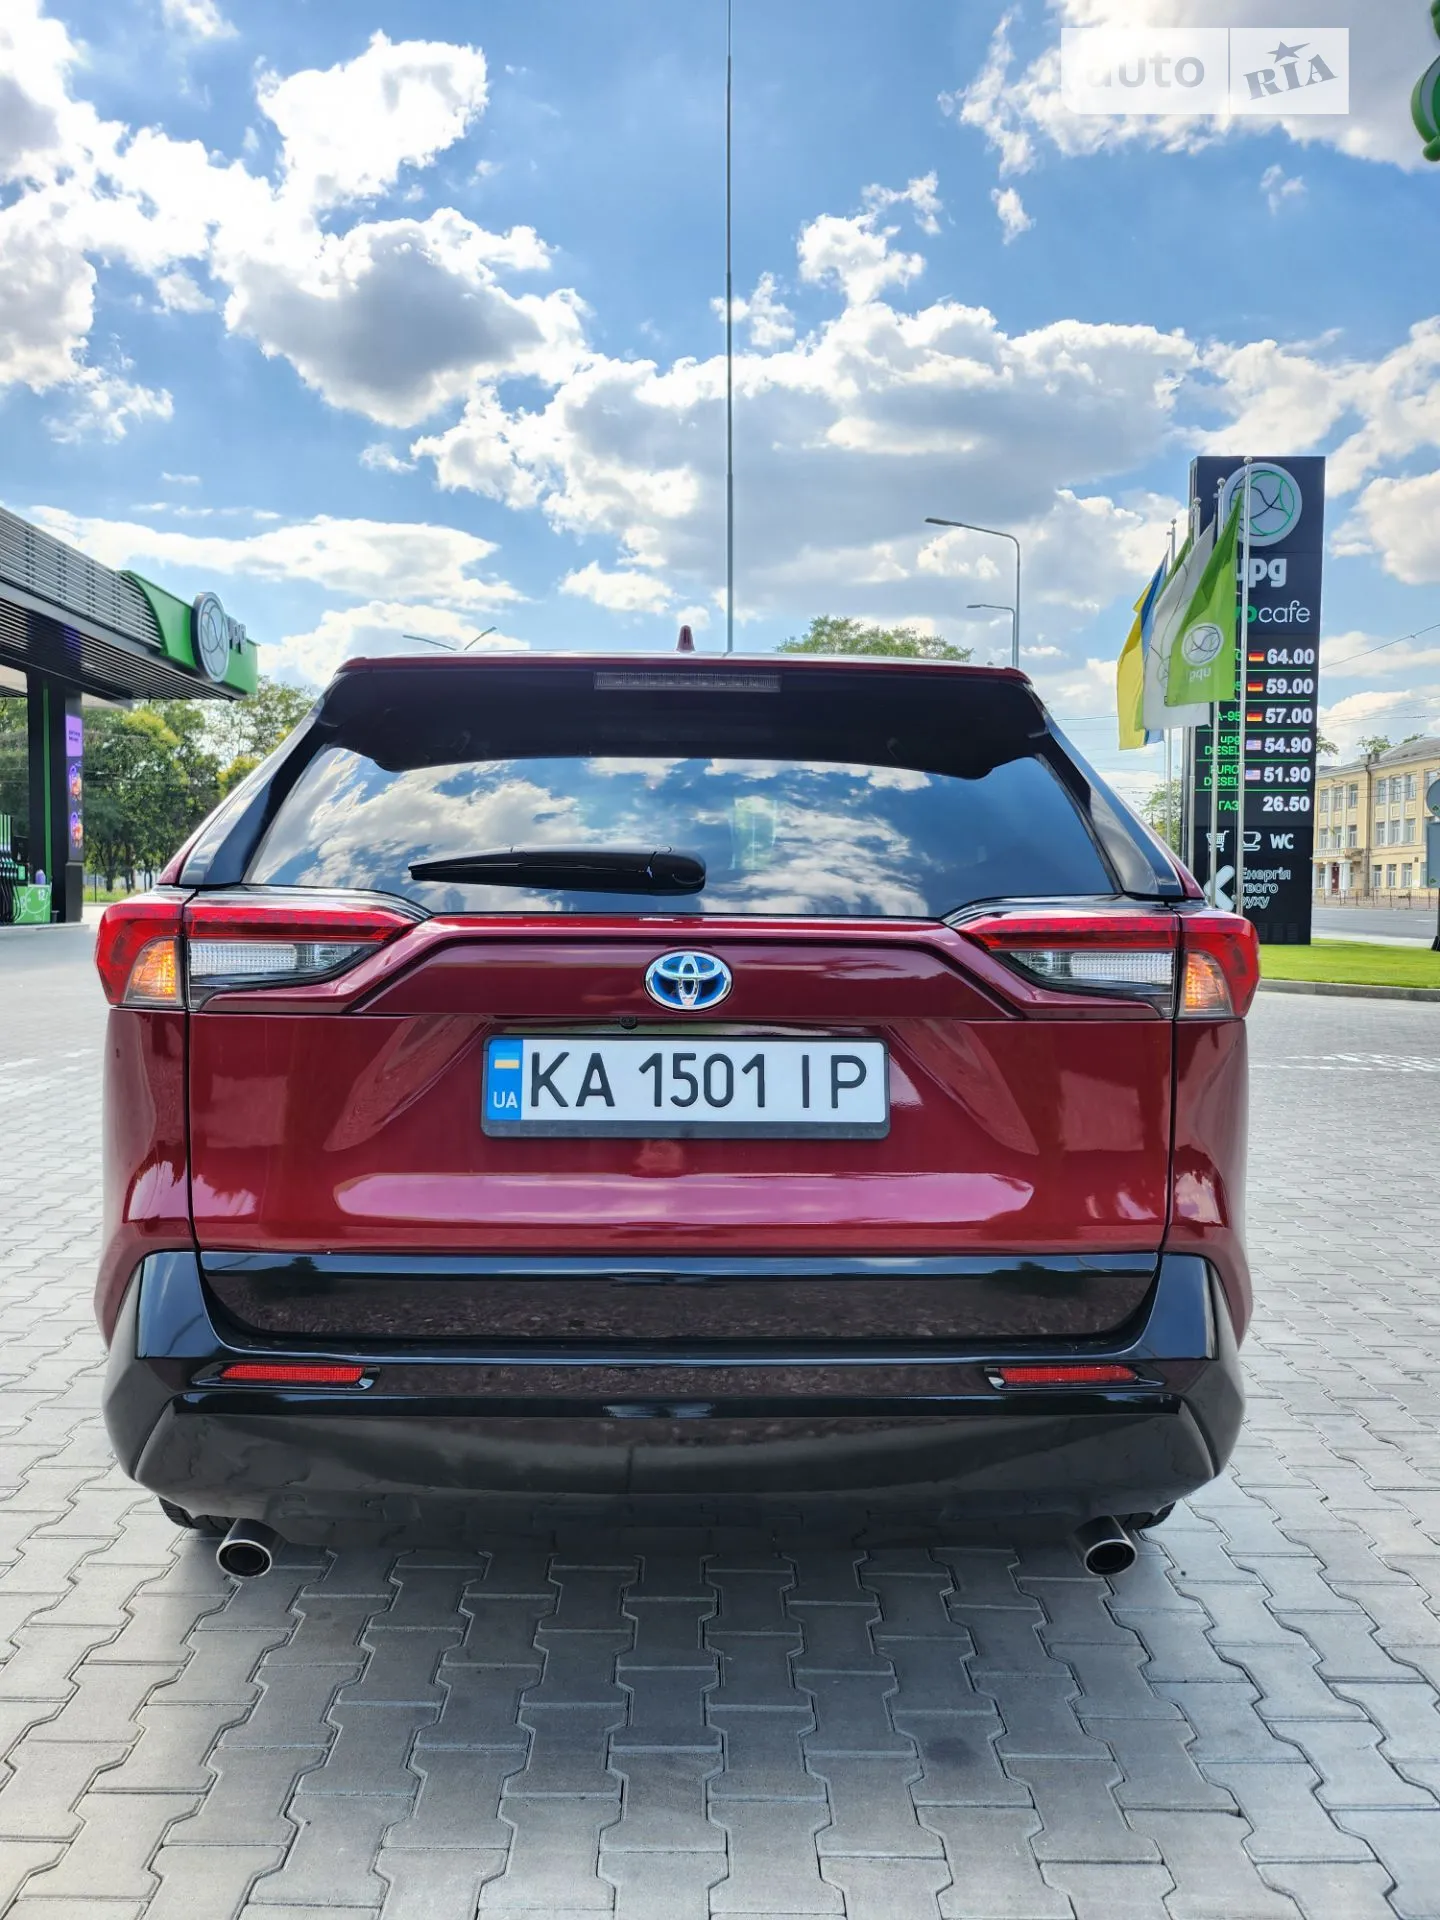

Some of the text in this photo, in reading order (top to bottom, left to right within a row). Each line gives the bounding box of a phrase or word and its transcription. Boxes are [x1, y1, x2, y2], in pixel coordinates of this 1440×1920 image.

[1267, 648, 1315, 664] 64.00
[1266, 678, 1314, 694] 59.00
[1265, 707, 1313, 723] 57.00
[1220, 735, 1240, 744] upg
[1264, 737, 1312, 753] 54.90
[1204, 746, 1240, 755] DESEL
[1203, 777, 1239, 786] DESEL
[1263, 766, 1311, 782] 51.90
[1218, 800, 1240, 810] ГАЗ
[1262, 796, 1310, 812] 26.50
[1269, 833, 1294, 849] WC
[531, 1052, 867, 1109] KA 1501 IP
[494, 1092, 517, 1109] UA
